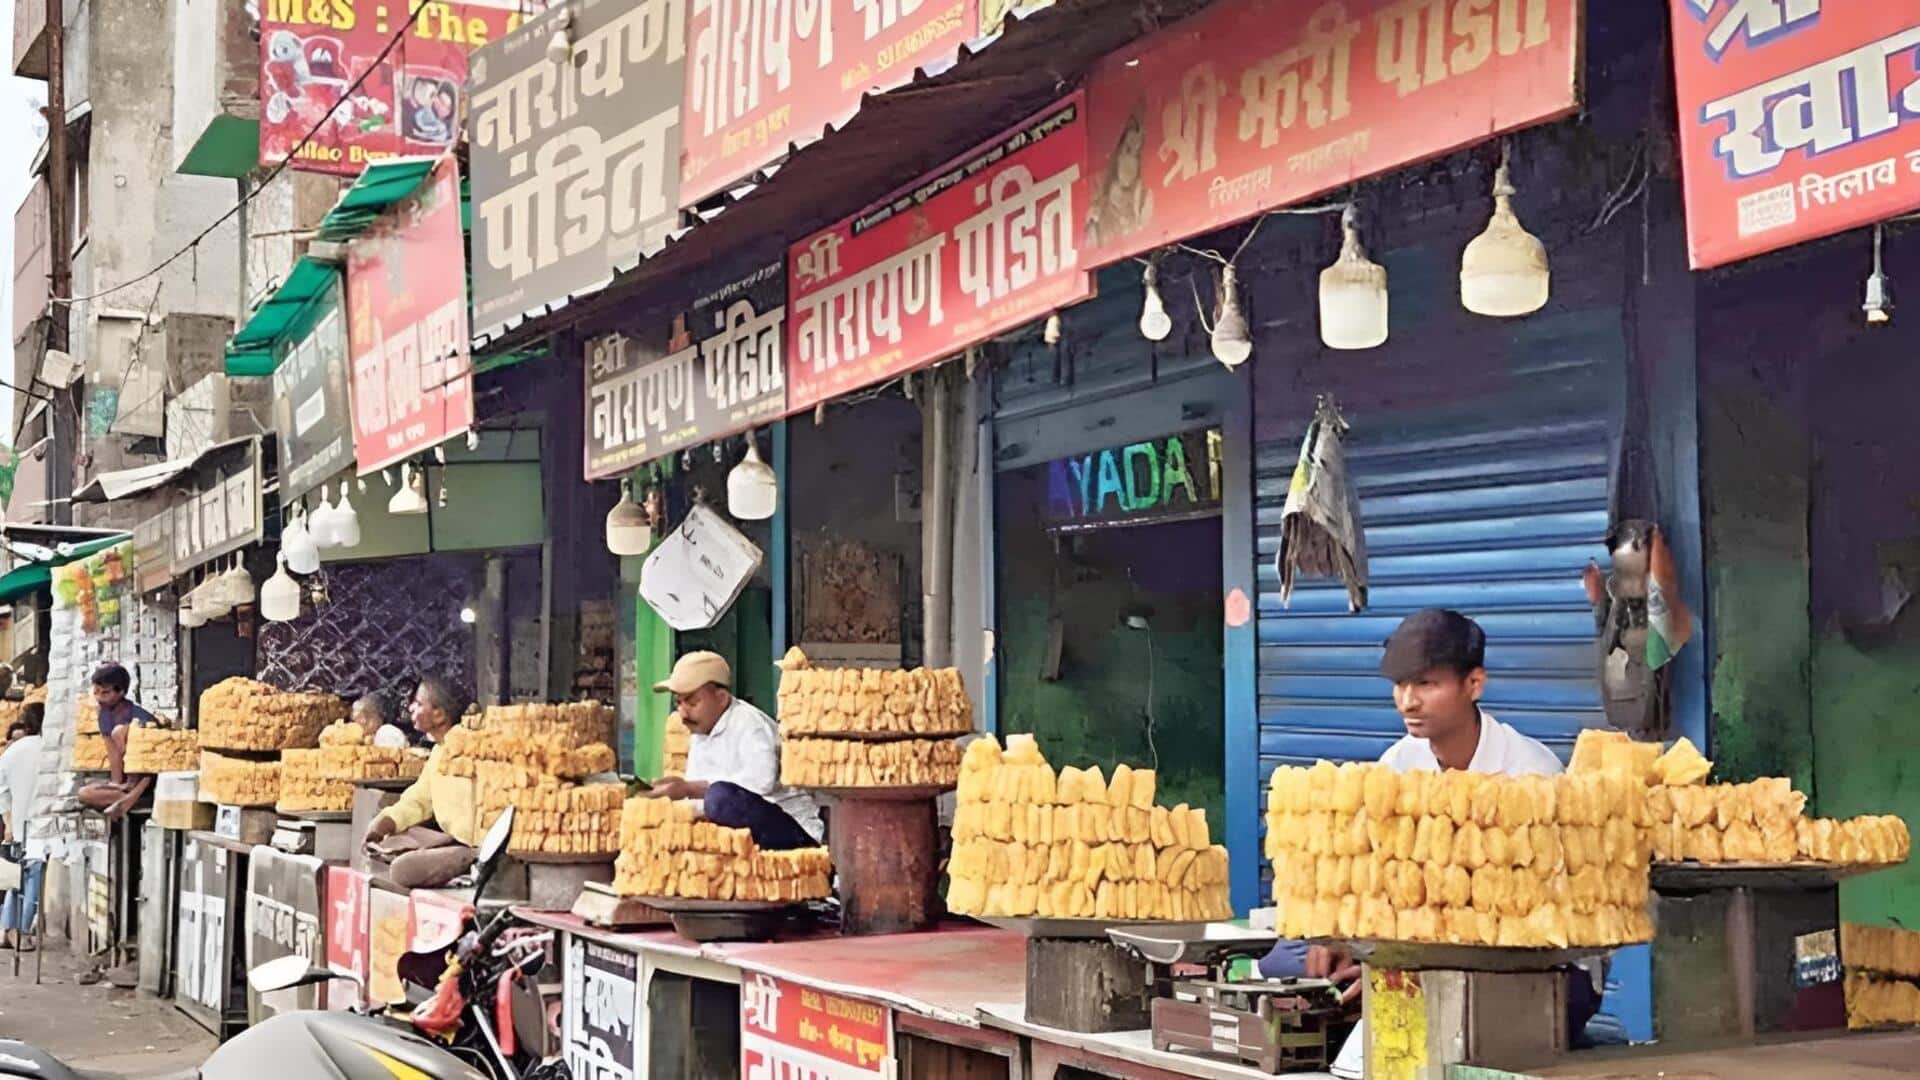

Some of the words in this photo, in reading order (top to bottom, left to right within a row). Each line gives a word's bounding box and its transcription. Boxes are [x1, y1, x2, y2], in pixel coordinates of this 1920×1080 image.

[268, 0, 357, 31] M&S
[409, 0, 488, 46] The
[472, 0, 686, 153] नारायण
[1159, 62, 1227, 188] श्री
[480, 104, 680, 281] पंडित
[1799, 158, 1897, 209] सिलाव
[794, 232, 845, 289] श्री
[794, 232, 945, 374] नारायण
[955, 164, 1081, 310] पंडित
[591, 344, 699, 449] नारायण
[702, 298, 785, 410] पंडित
[593, 331, 631, 379] श्री
[744, 973, 783, 1034] श्री
